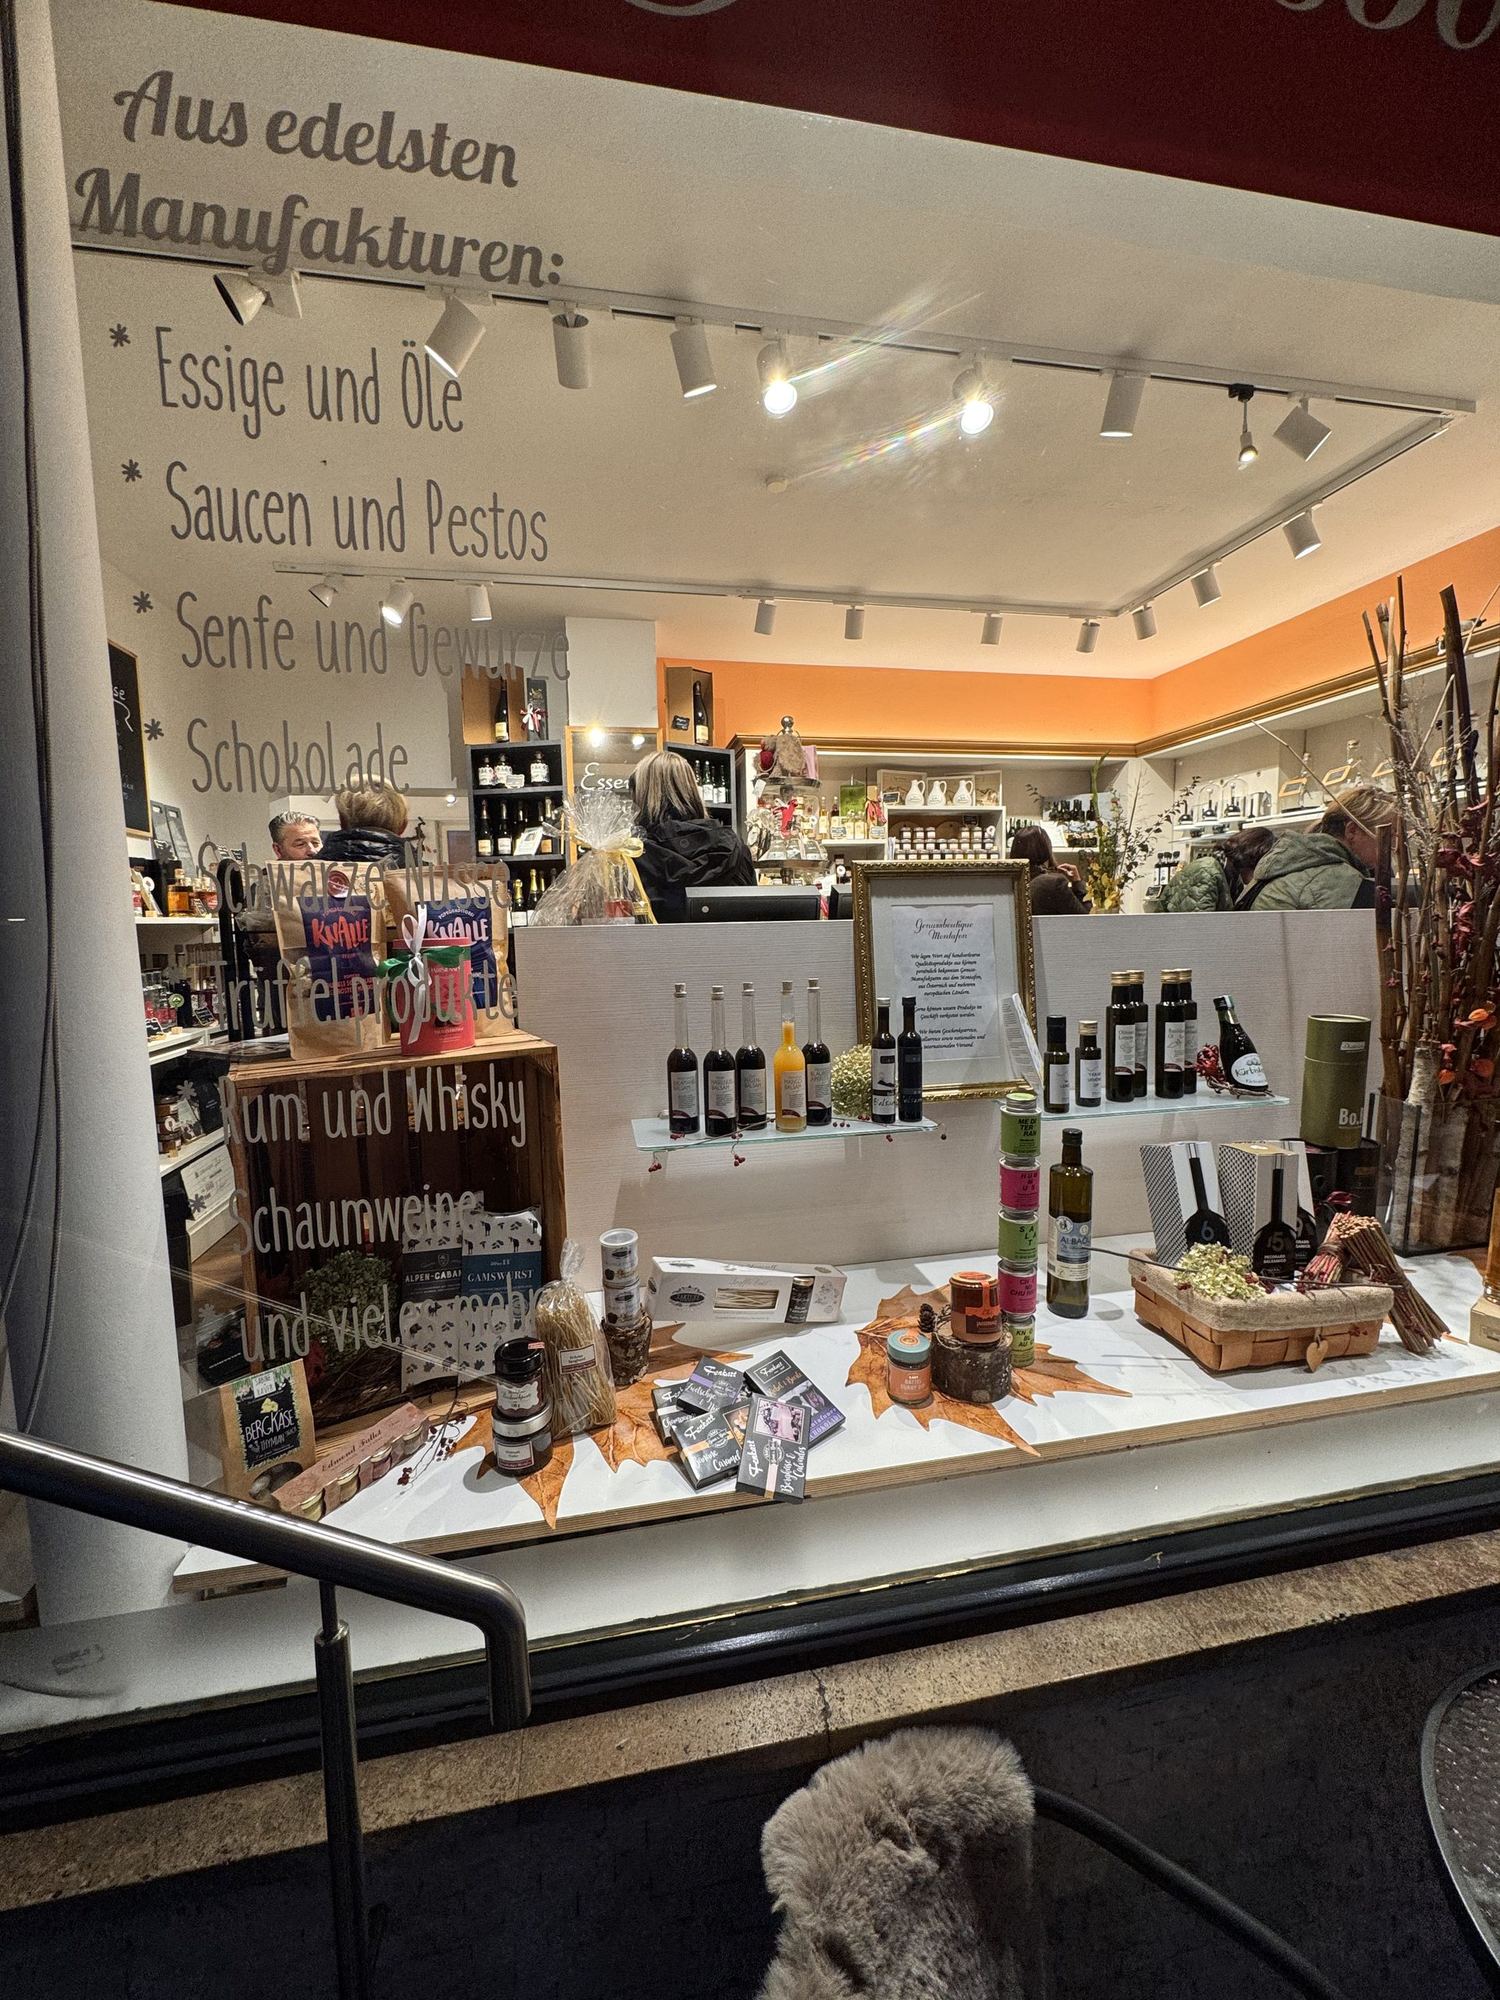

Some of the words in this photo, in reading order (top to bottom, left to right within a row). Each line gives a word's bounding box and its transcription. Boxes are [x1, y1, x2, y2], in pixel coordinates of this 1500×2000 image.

[114, 70, 249, 147] Aus
[265, 102, 519, 188] edelsten
[74, 166, 566, 287] Manufakturen:
[154, 326, 286, 439] Essige
[307, 346, 381, 425] und
[402, 340, 464, 432] Öle
[165, 461, 312, 548] Saucen
[333, 476, 406, 553] und
[425, 478, 548, 562] Pestos
[176, 591, 297, 673] Senfe
[316, 600, 389, 676] und
[187, 718, 409, 796] Schokolade
[198, 841, 386, 914] Schwarze
[208, 954, 518, 1047] Trüffelprodukte
[220, 1076, 306, 1145] Rum
[323, 1066, 393, 1137] und
[412, 1063, 526, 1148] Whisky
[229, 1184, 483, 1257] Schaumweine
[467, 1269, 535, 1283] GAMSWURST
[241, 1291, 309, 1362] und
[245, 1408, 295, 1443] BERGKÄSE
